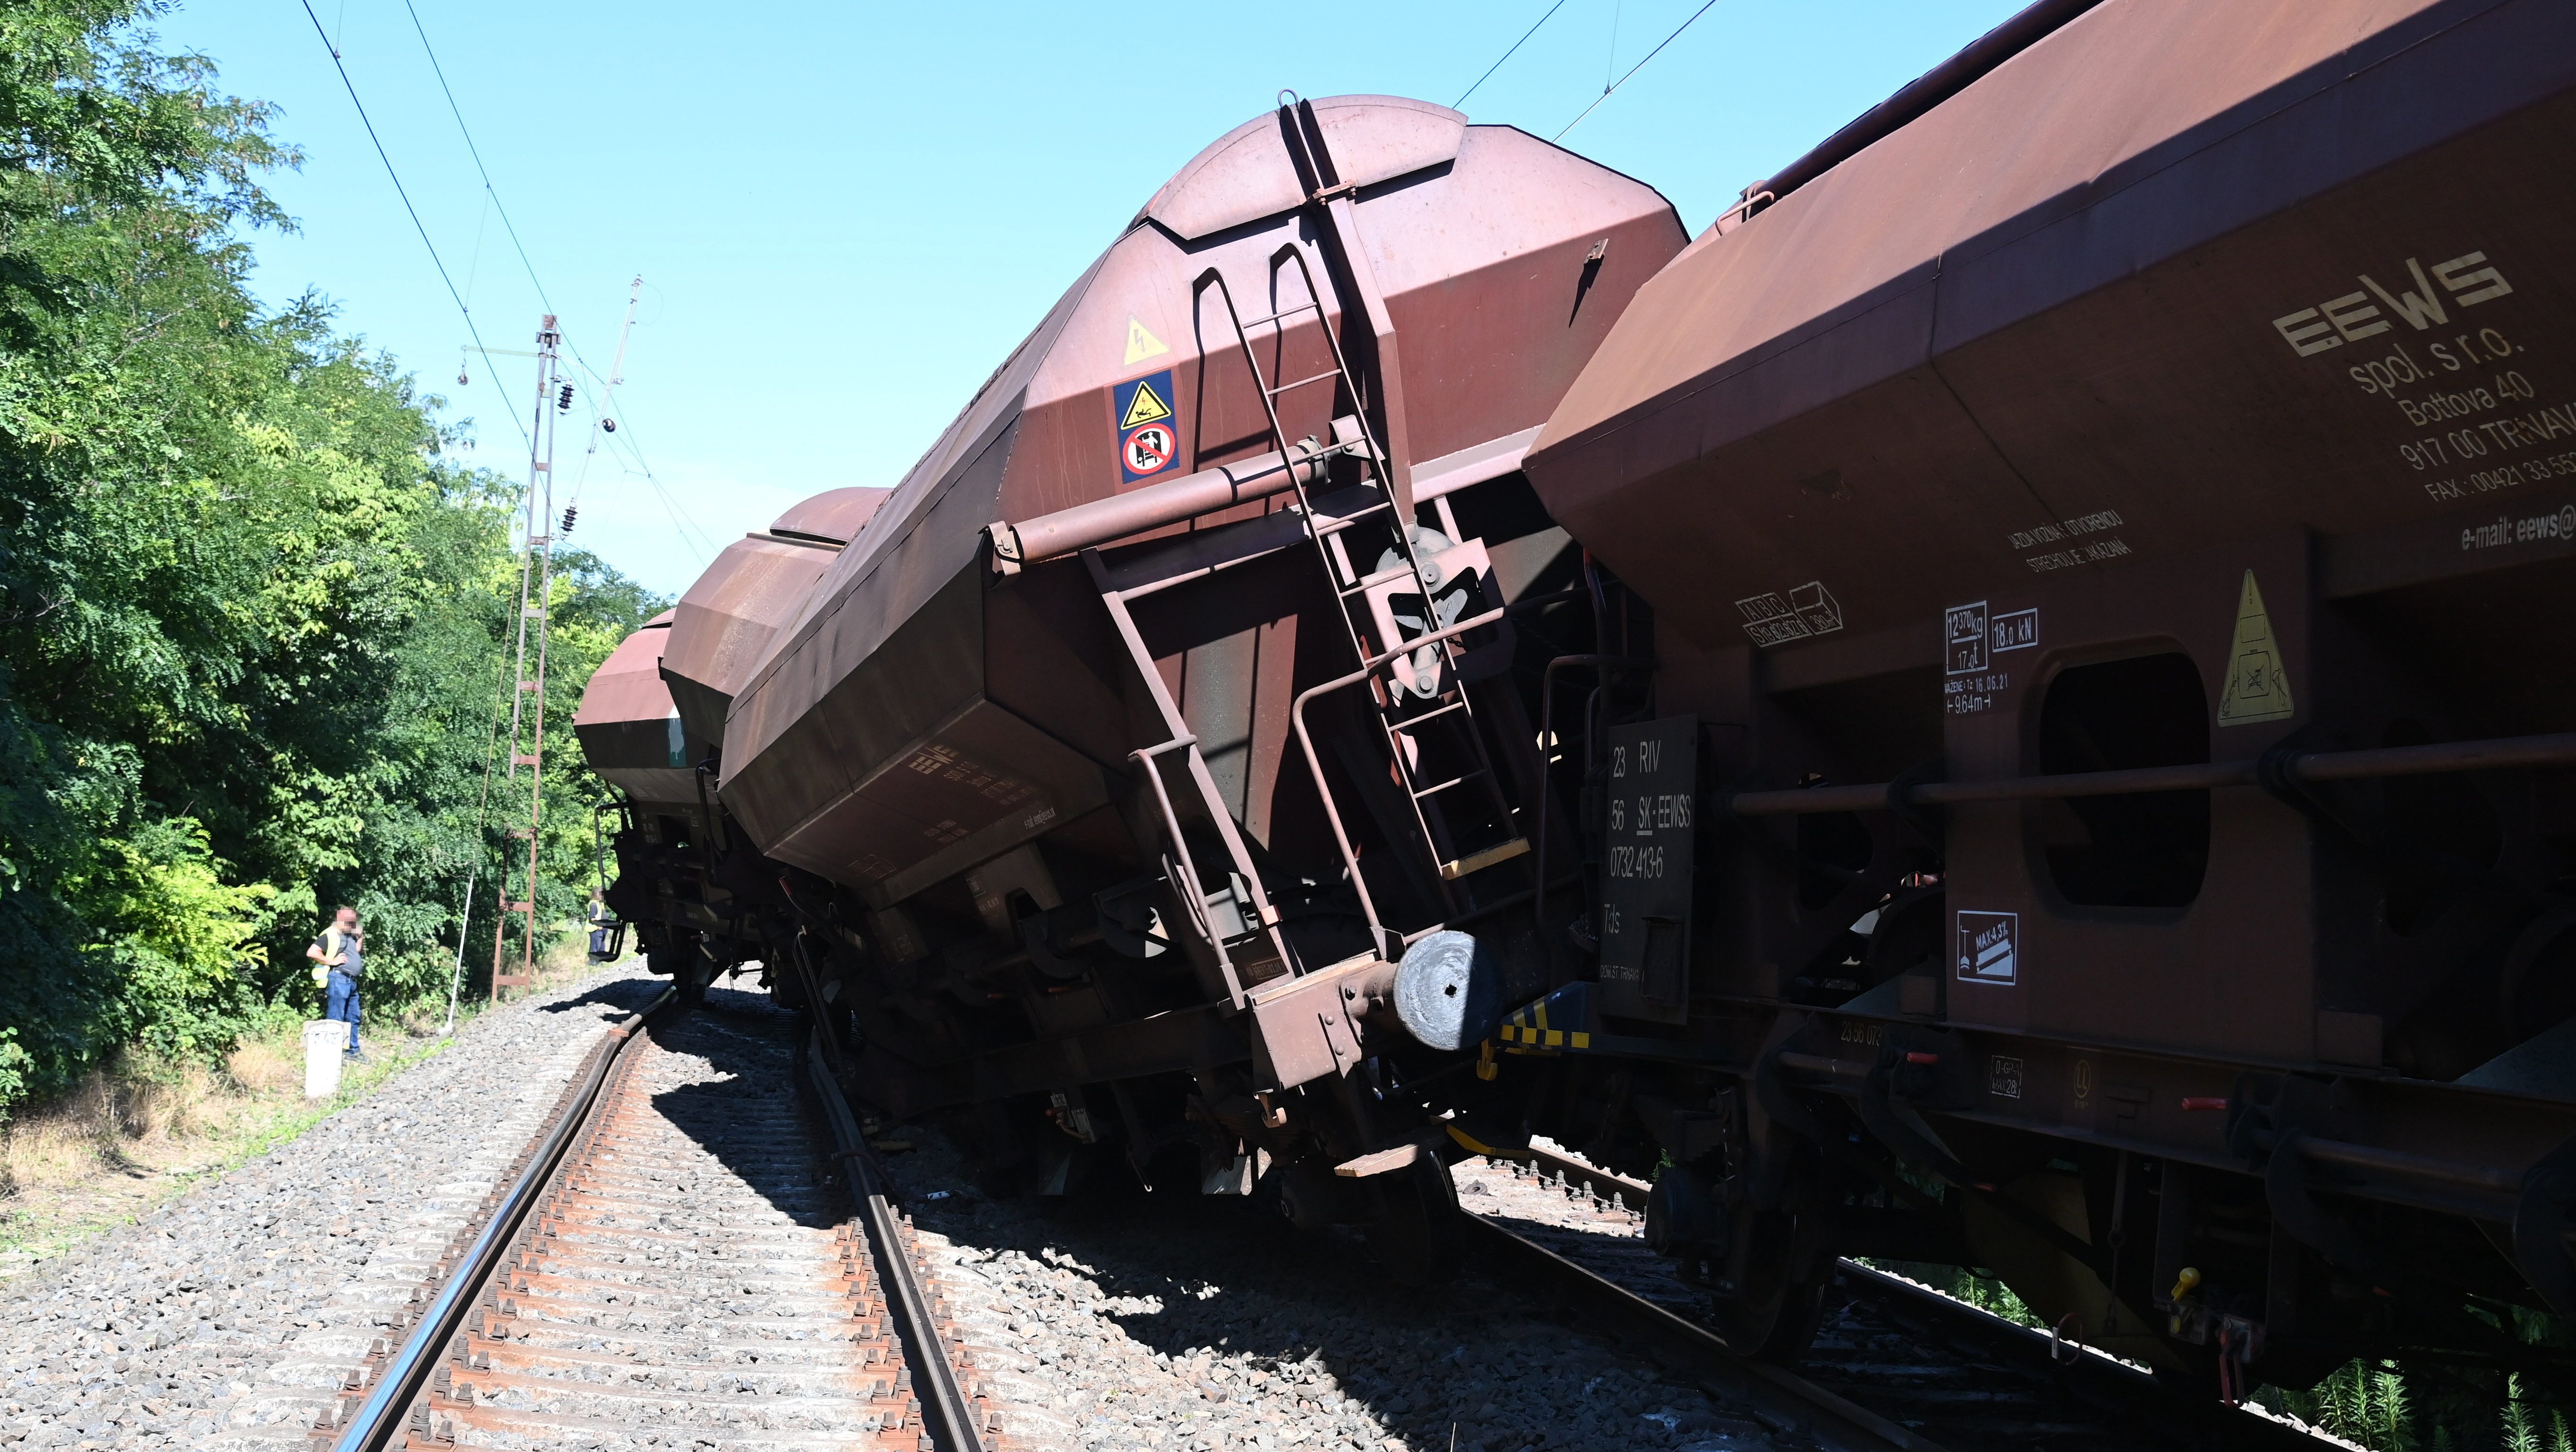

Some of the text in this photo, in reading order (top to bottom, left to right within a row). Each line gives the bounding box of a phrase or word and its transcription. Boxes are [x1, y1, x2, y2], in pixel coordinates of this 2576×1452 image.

[2272, 251, 2514, 357] EEWS
[2349, 328, 2525, 399] spol. s r.o.
[2398, 371, 2535, 427] Bottova 40
[2400, 401, 2576, 471] 917 00 TRNAV
[2470, 465, 2526, 492] 00421
[2523, 460, 2552, 481] 33
[2007, 531, 2038, 549] JAZDA
[2064, 509, 2124, 536] OTVORENOU
[2462, 515, 2512, 550] e-mail:
[2026, 551, 2074, 573] STRECHOU
[1745, 597, 1785, 620] A B C
[1749, 627, 1766, 643] S
[2018, 616, 2032, 642] kN
[1613, 740, 1661, 778] 23 RIV
[1611, 799, 1625, 831] 56
[1610, 845, 1663, 879] 0732 413-6
[1604, 903, 1620, 934] Tds
[1620, 966, 1639, 981] TRNAVA
[1841, 1021, 1851, 1042] 23
